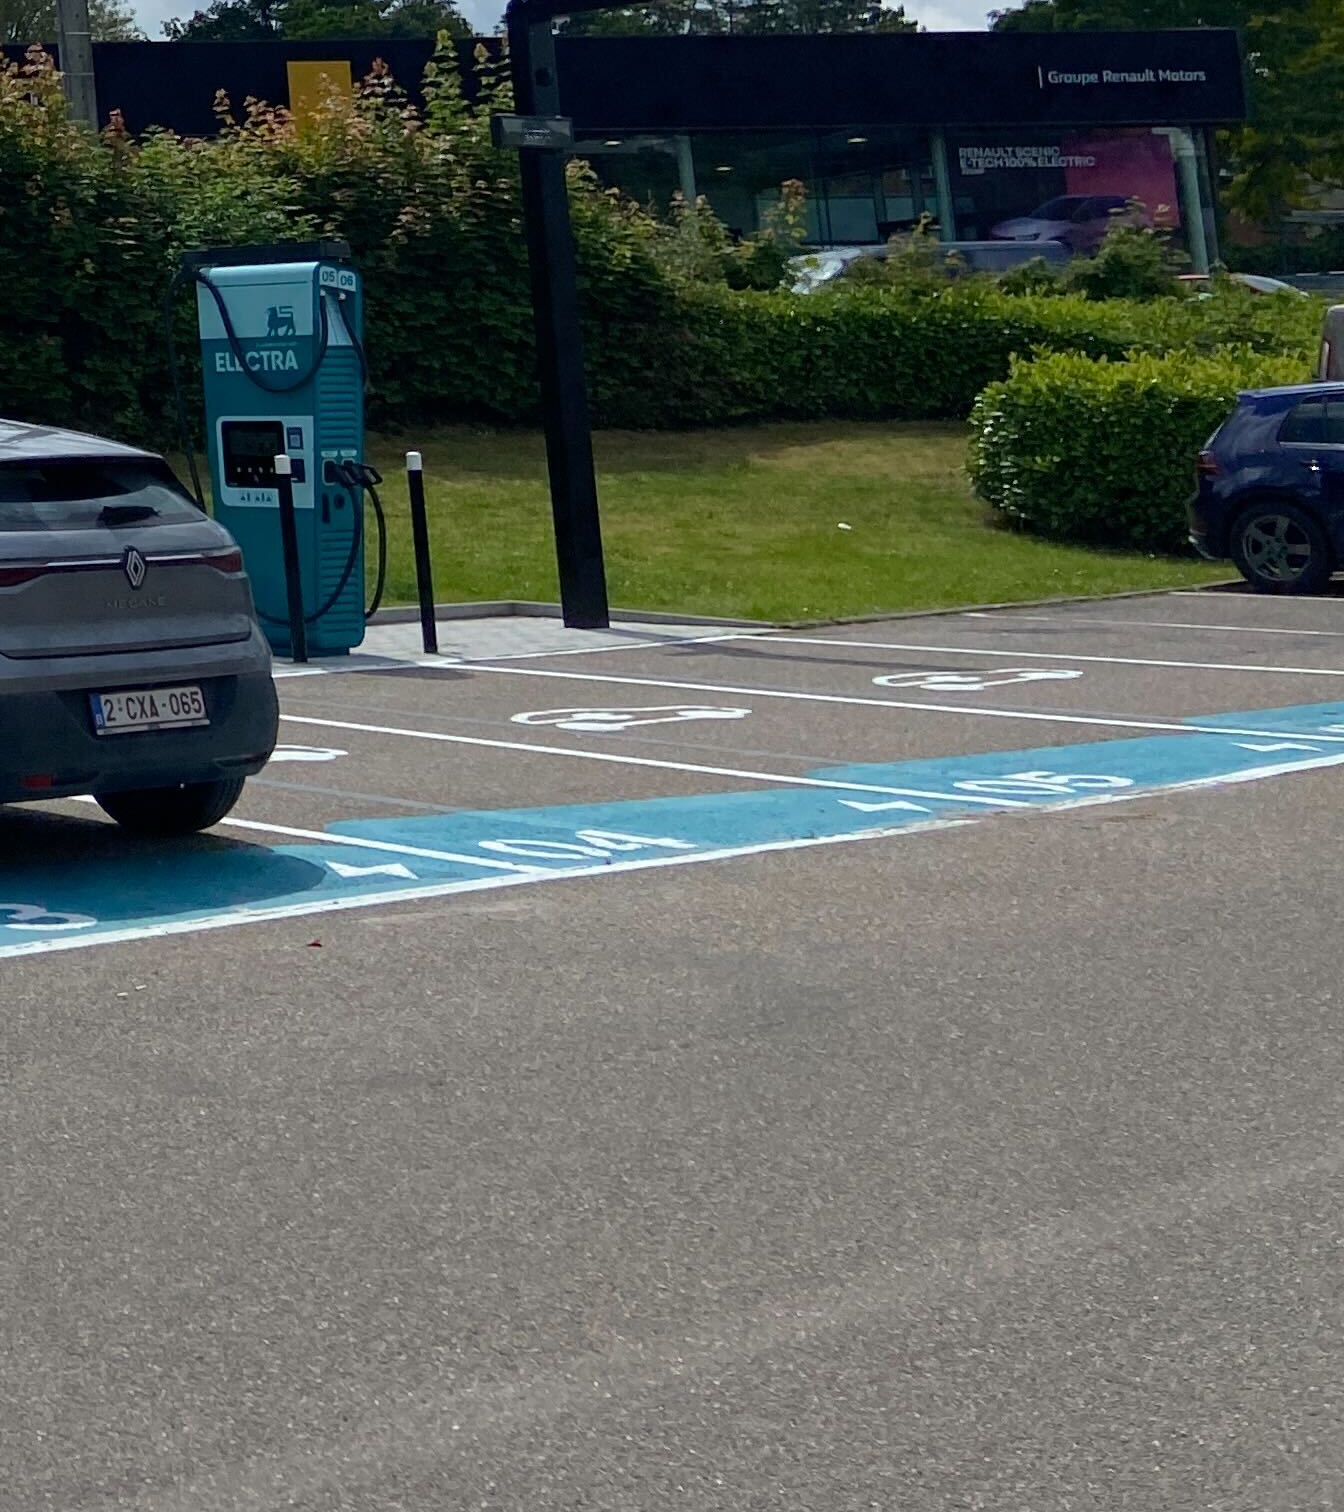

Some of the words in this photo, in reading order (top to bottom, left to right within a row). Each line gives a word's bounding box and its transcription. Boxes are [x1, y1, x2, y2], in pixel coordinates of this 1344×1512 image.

[1048, 70, 1099, 86] Groupe
[1102, 68, 1156, 83] Renault
[1158, 69, 1207, 82] Motors
[958, 147, 1013, 158] RENAULT
[1037, 155, 1097, 168] ELECTRIC
[322, 270, 336, 283] 05
[340, 273, 354, 287] 06
[478, 828, 698, 861] 04
